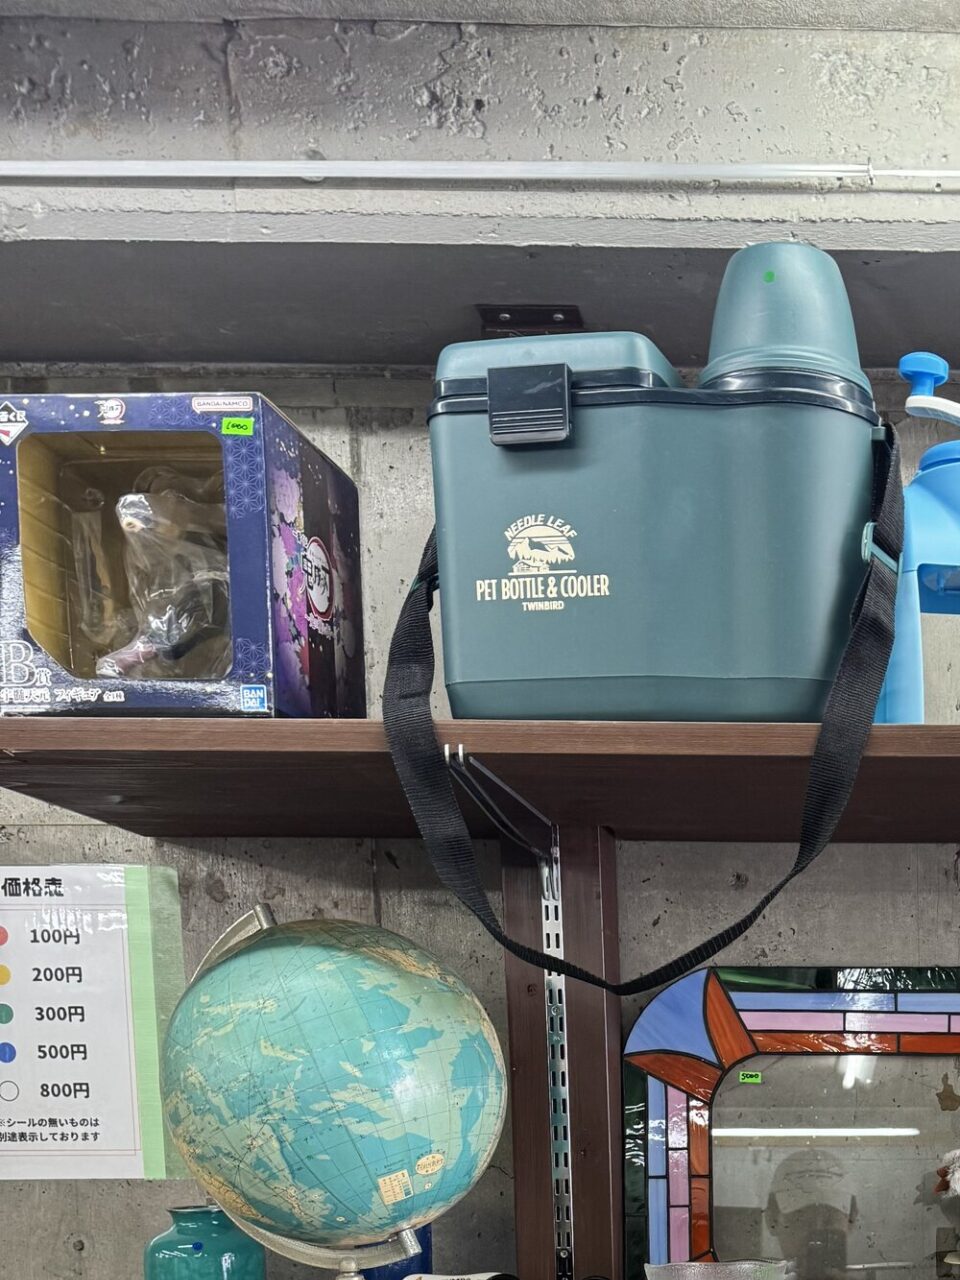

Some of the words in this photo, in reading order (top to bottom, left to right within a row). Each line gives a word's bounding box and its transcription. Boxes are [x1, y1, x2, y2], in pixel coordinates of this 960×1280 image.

[504, 514, 545, 541] NEEDLE
[546, 515, 578, 538] LEAF
[476, 580, 498, 601] PET
[501, 577, 545, 600] BOTTLE
[546, 576, 558, 598] &
[561, 574, 610, 598] COOLER
[522, 601, 565, 611] TWINBIRD
[243, 689, 263, 698] BAN
[1, 877, 64, 897] 価格表
[30, 927, 80, 944] 100円
[32, 966, 82, 983] 200円
[35, 1005, 85, 1023] 300円
[37, 1044, 87, 1061] 500円
[40, 1082, 90, 1099] 800円
